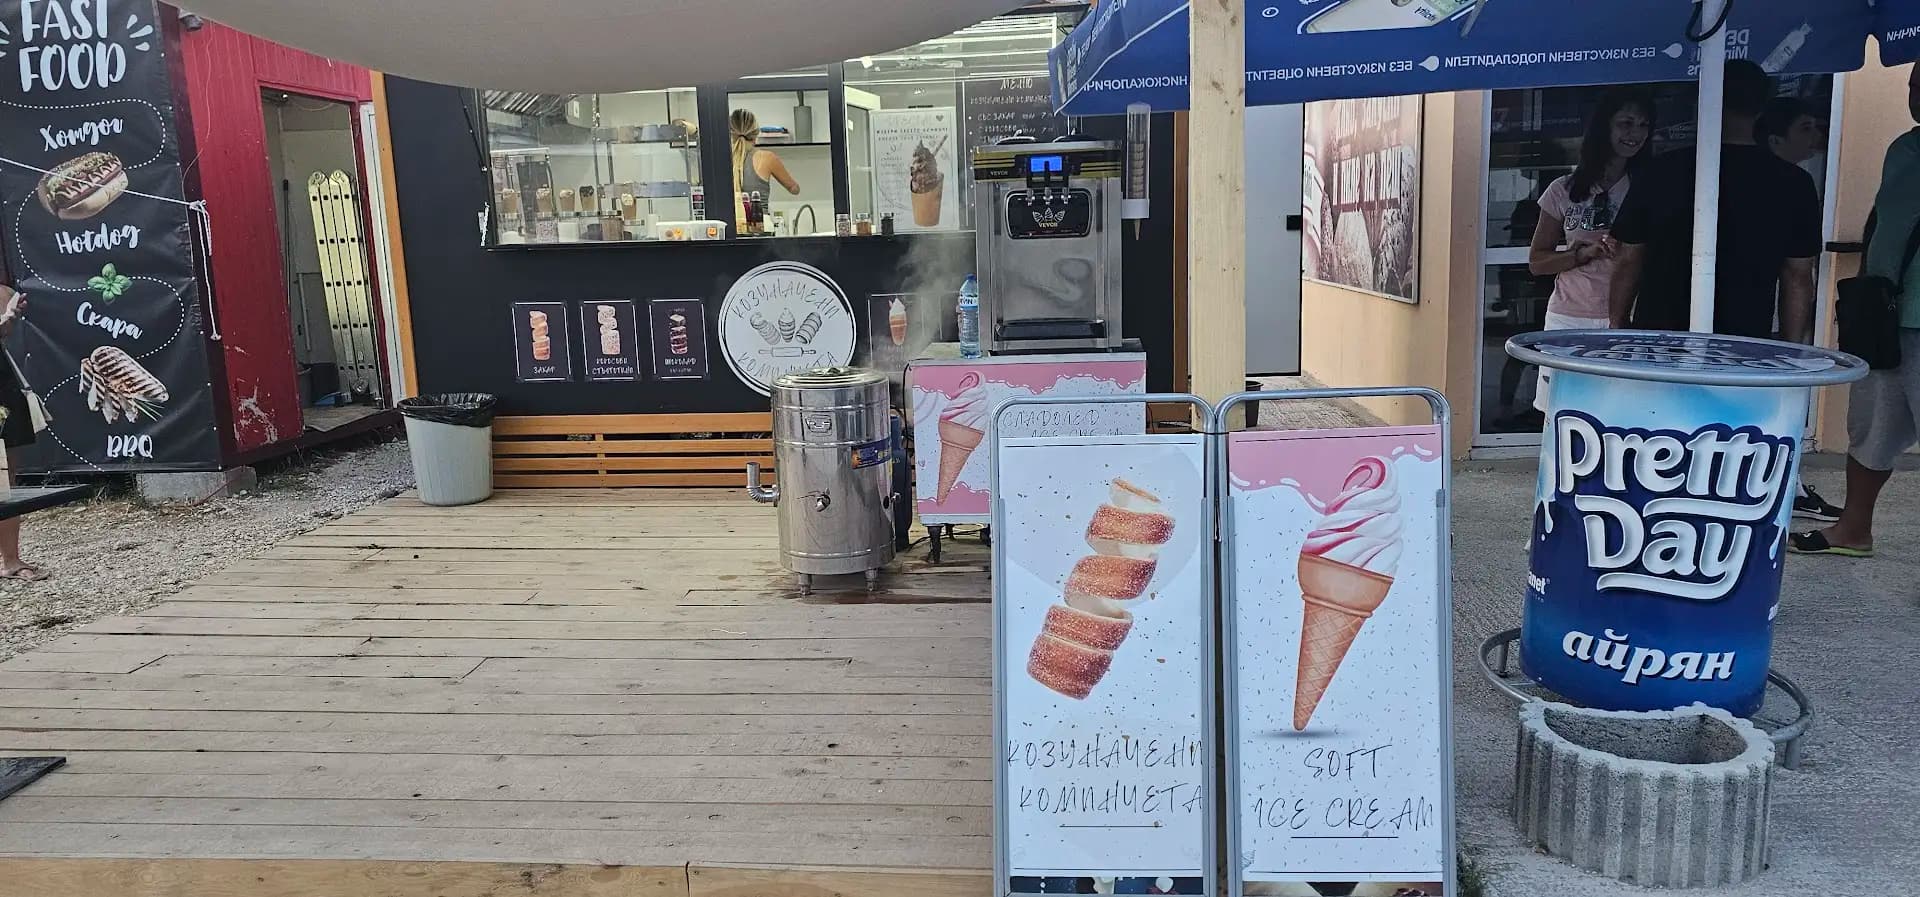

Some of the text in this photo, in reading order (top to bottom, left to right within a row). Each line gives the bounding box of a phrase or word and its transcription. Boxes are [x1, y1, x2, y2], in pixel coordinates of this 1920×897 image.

[19, 42, 126, 92] FOOD
[40, 118, 123, 151] Хотдог
[55, 223, 141, 254] Hotdog
[731, 278, 840, 319] КОЗУНАЧЕНИ
[77, 302, 142, 340] Скара
[107, 435, 153, 459] BBQ
[1557, 417, 1790, 521] Pretty
[1575, 494, 1752, 600] Day
[1562, 628, 1736, 684] айрян
[1008, 736, 1204, 770] КОЗУНАЧЕНИ
[1304, 744, 1392, 779] SOFT
[1020, 780, 1204, 815] КОМИНЧЕТА
[1254, 798, 1433, 832] ICE CREAM
